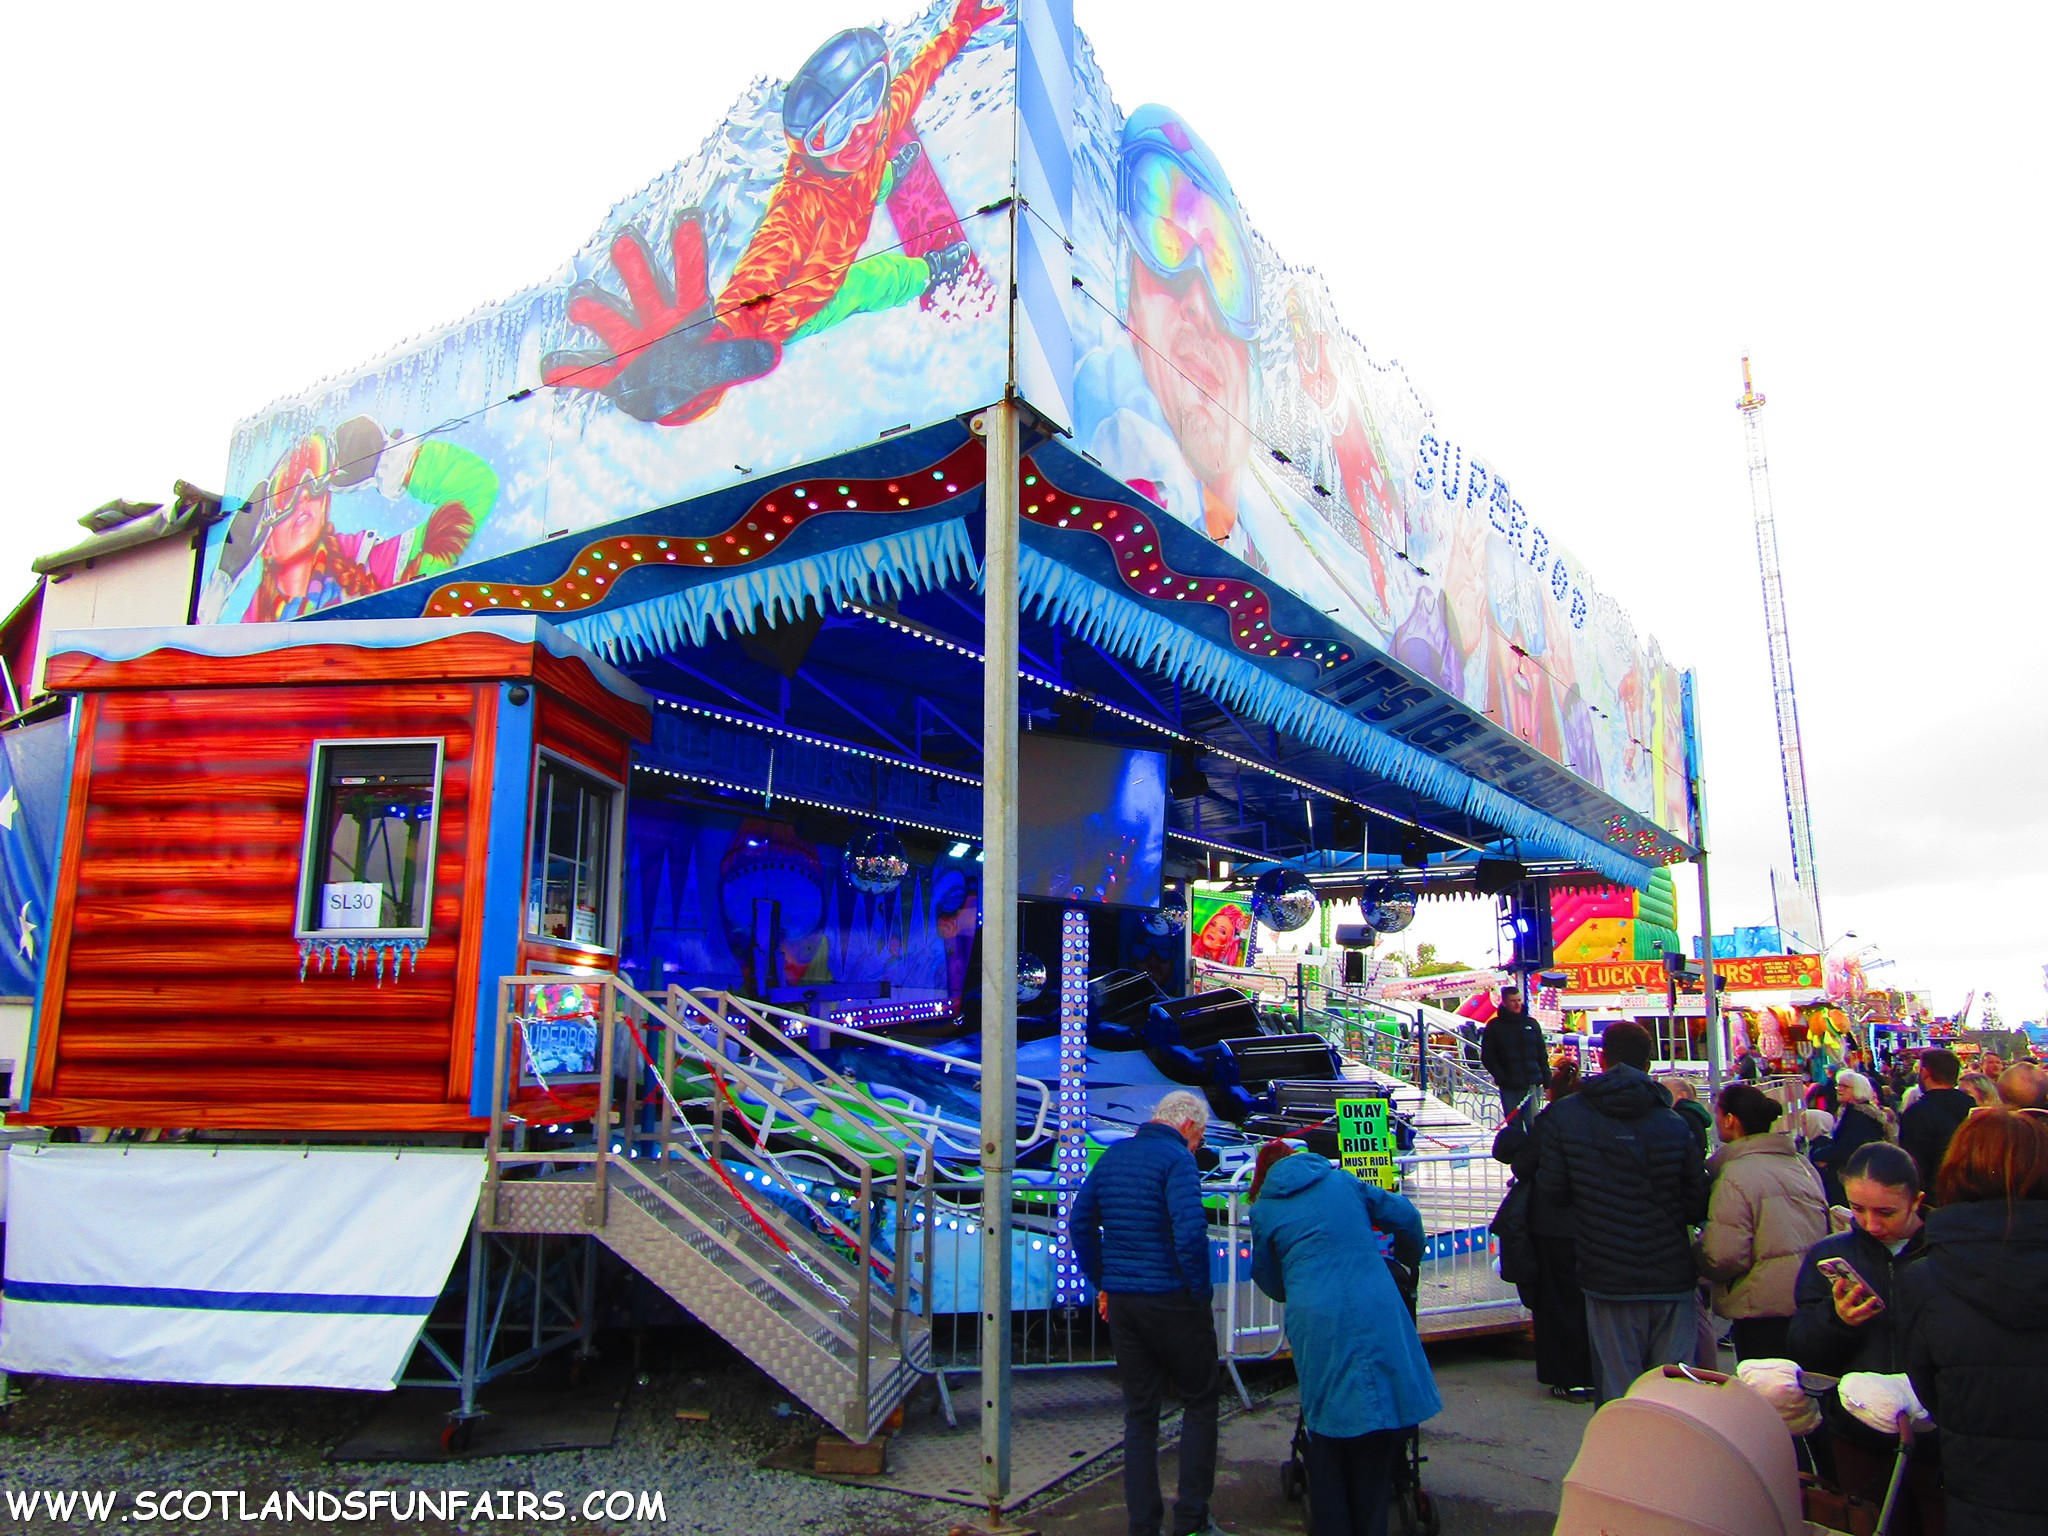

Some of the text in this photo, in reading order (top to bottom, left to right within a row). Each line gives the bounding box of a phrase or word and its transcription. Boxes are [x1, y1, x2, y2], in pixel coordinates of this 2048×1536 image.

[1314, 659, 1434, 722] IT'S
[1391, 702, 1489, 754] ICE
[1449, 736, 1537, 781] ICE
[330, 894, 373, 911] SL30
[1587, 965, 1651, 988] LUCKY
[1342, 1104, 1382, 1119] OKAY
[1354, 1121, 1374, 1135] TO
[1343, 1138, 1379, 1153] RIDE
[1344, 1156, 1389, 1167] MUST RIDE
[1356, 1168, 1379, 1178] WITH
